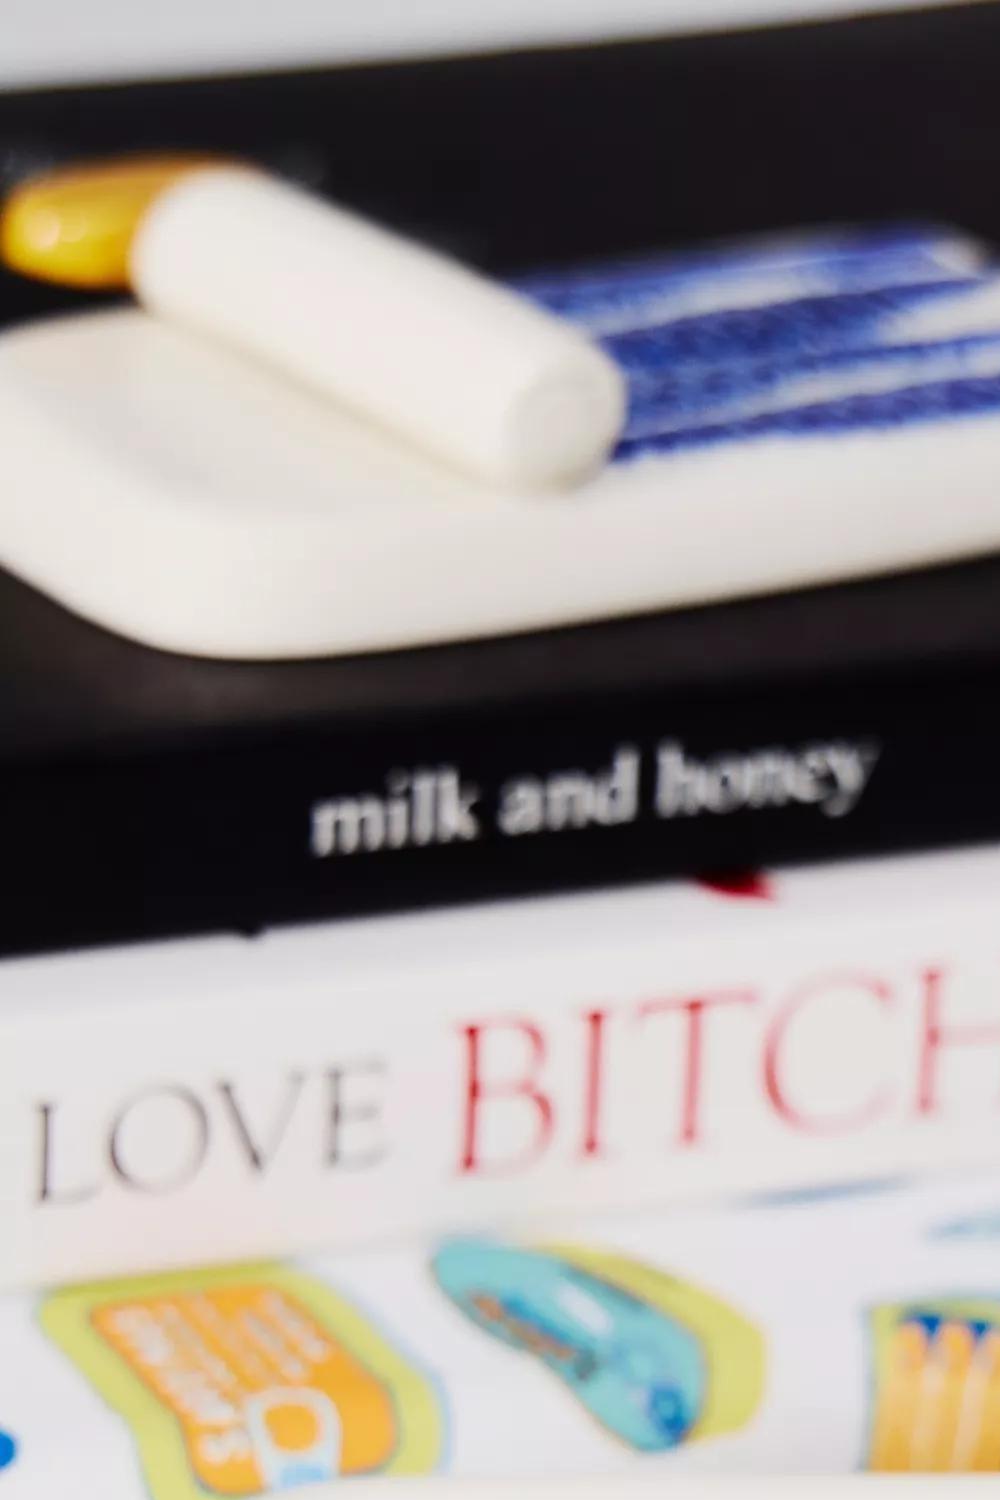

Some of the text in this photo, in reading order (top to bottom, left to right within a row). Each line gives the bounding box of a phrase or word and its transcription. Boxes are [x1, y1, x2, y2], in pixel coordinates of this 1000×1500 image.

[312, 738, 876, 857] milk and honey
[34, 1056, 390, 1205] LOVE
